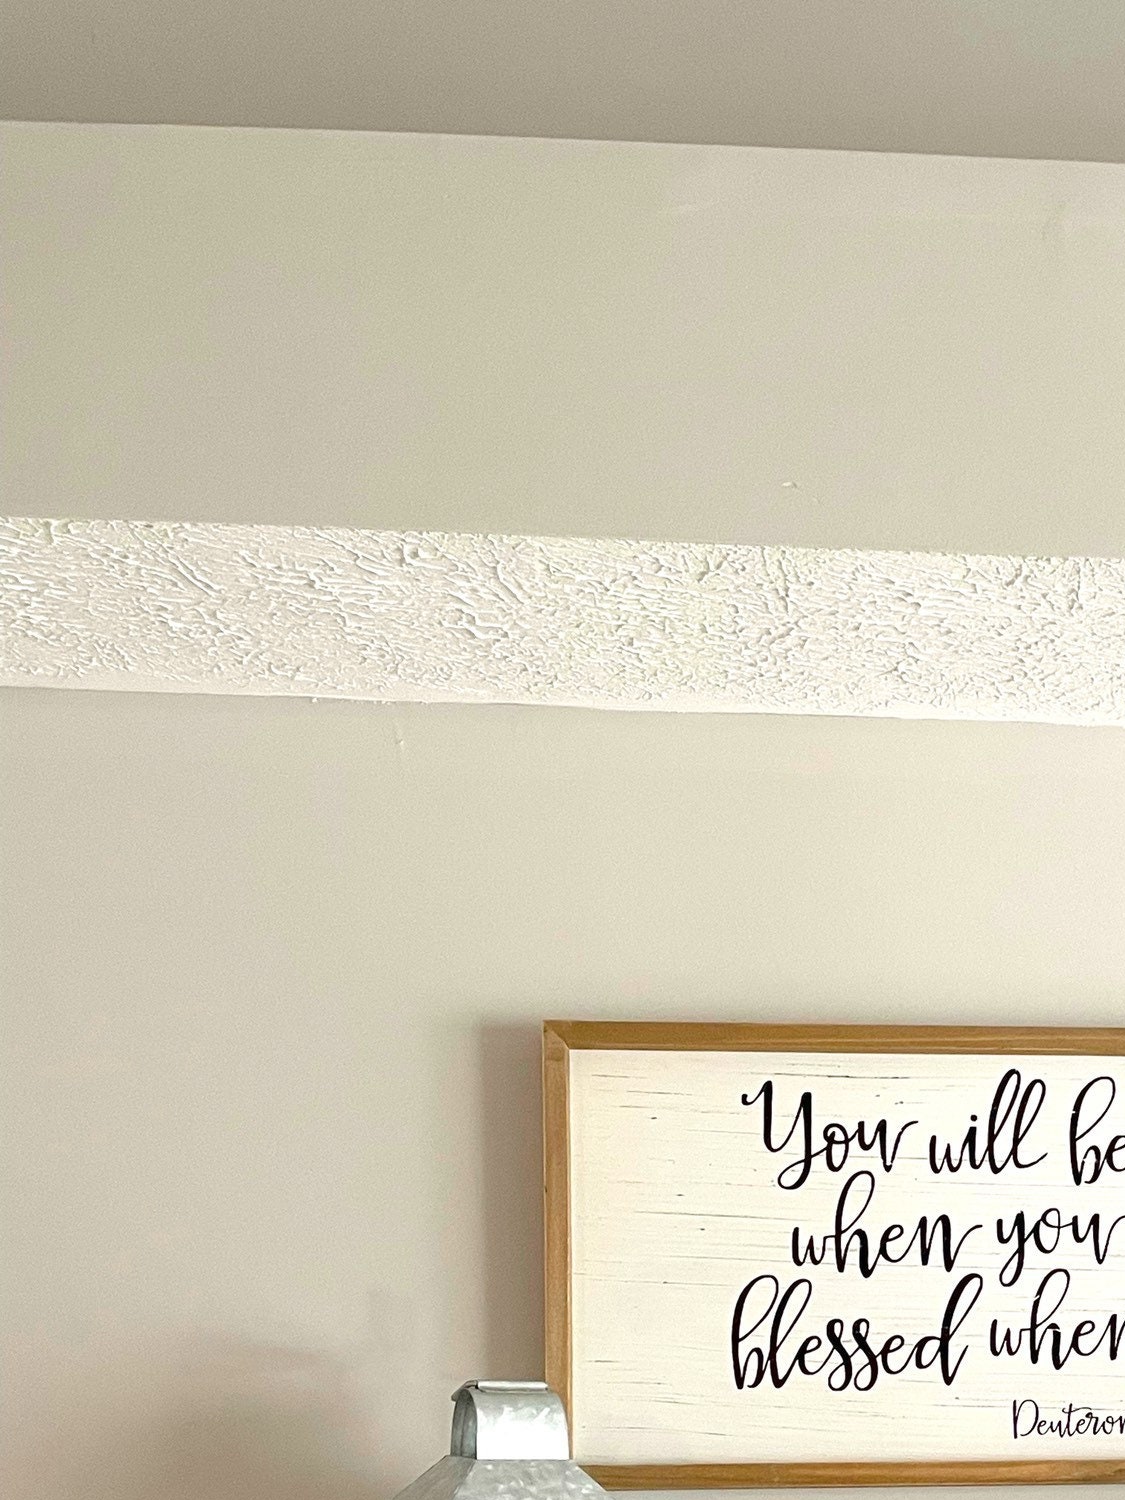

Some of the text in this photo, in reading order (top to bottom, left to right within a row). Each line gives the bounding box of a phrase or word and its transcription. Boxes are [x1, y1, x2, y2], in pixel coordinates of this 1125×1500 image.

[741, 1080, 919, 1191] You
[928, 1068, 1049, 1175] will
[791, 1170, 983, 1279] when
[731, 1272, 984, 1392] blessed
